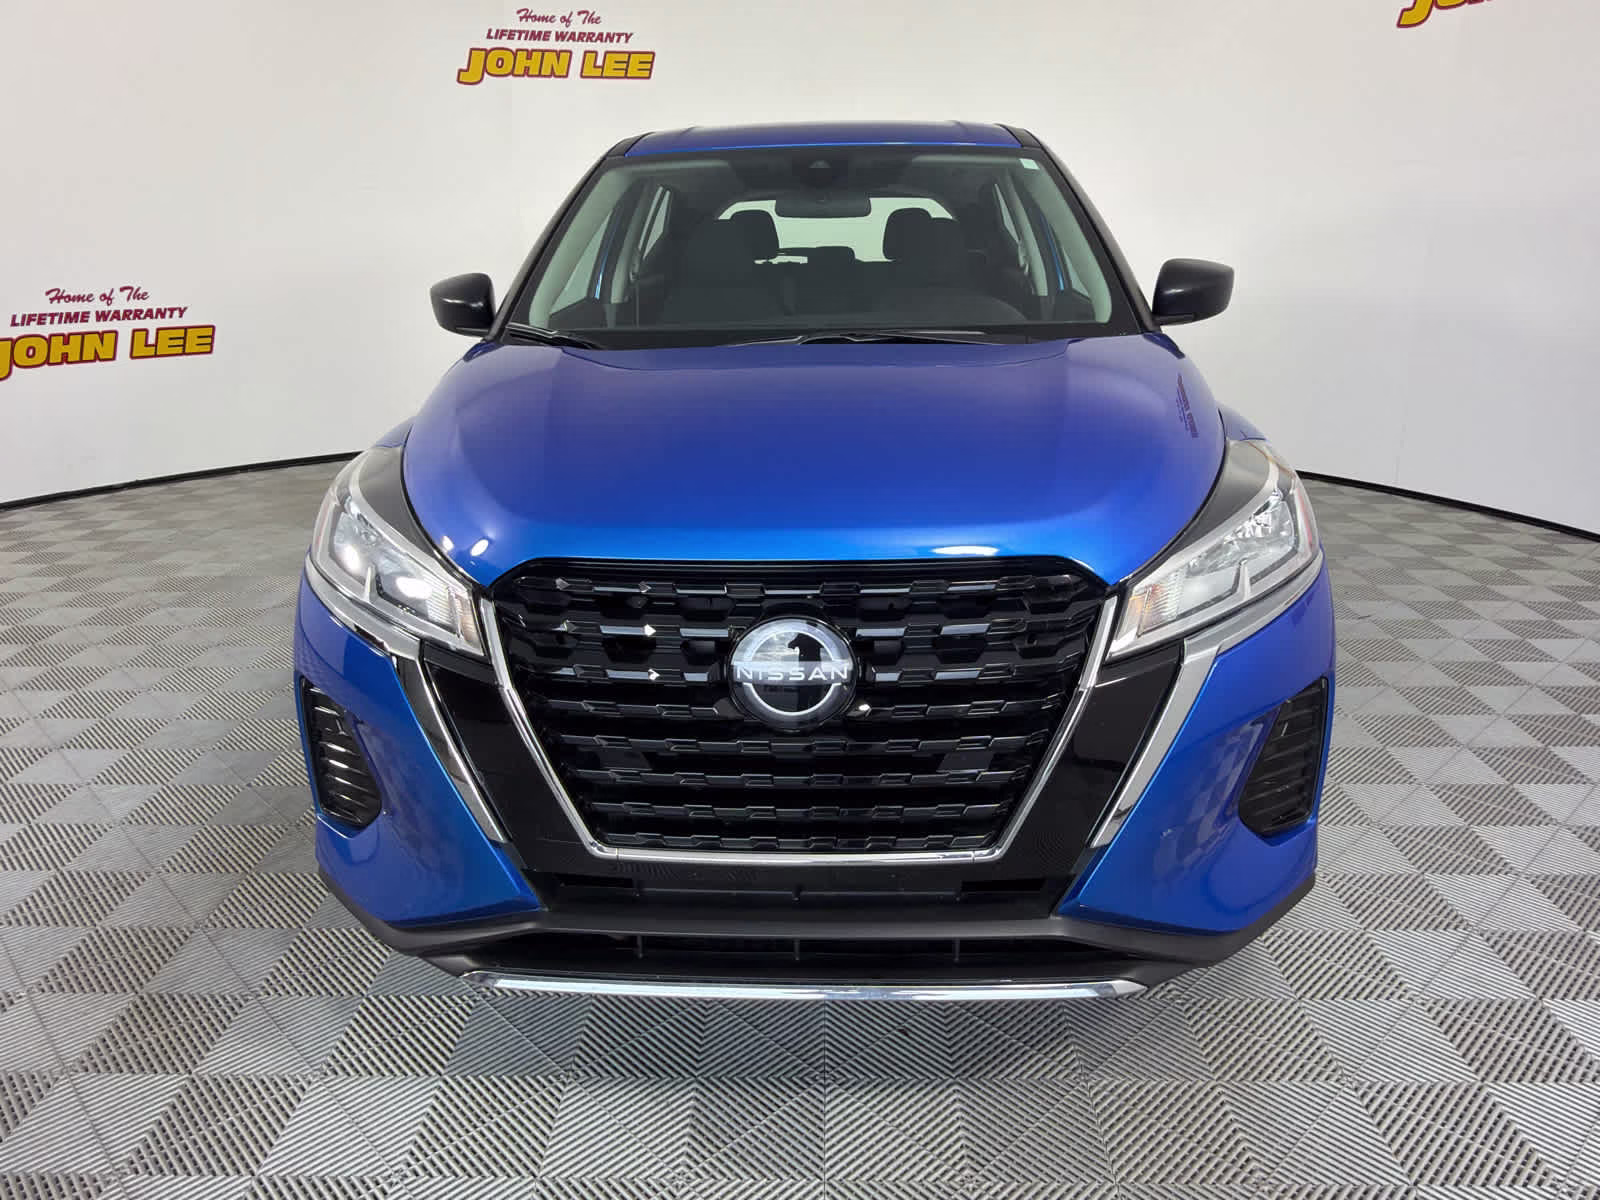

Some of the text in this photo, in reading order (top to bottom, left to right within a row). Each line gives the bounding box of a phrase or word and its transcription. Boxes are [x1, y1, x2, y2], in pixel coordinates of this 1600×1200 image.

[516, 8, 602, 27] Home of The
[486, 28, 633, 43] LIFETIME WARRANTY
[457, 47, 655, 85] JOHN LEE
[45, 286, 149, 306] Home of The
[10, 307, 187, 327] LIFETIME WARRANTY
[130, 325, 215, 359] LEE
[736, 665, 848, 681] NISSAN
